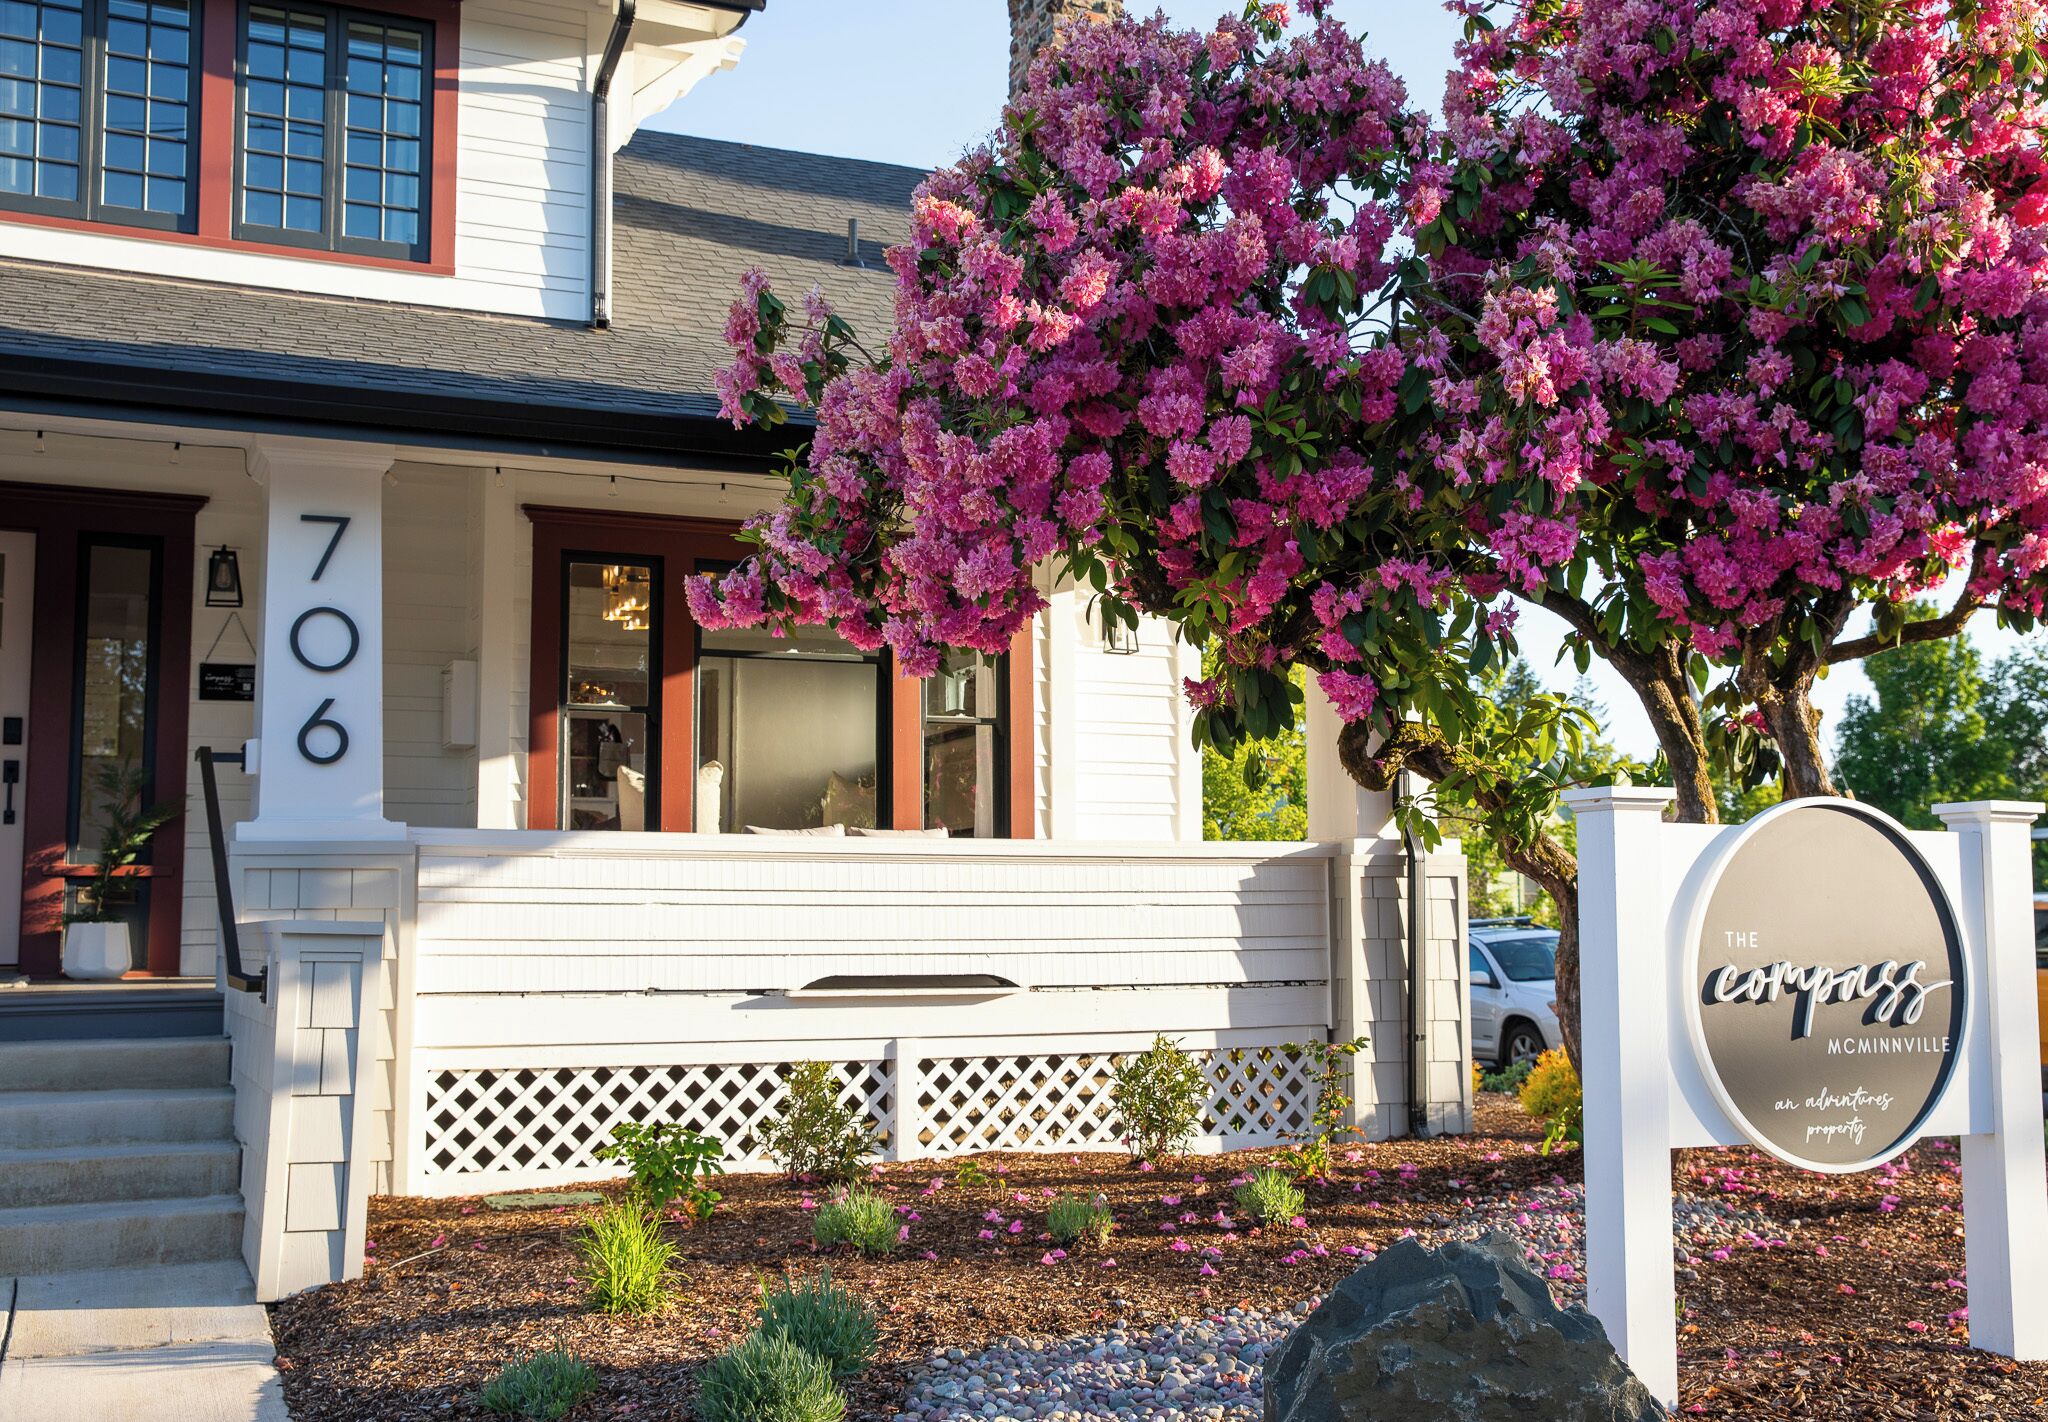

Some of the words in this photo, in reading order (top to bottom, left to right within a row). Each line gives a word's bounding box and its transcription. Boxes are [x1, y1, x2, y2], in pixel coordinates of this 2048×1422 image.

[289, 514, 360, 765] 706
[1725, 931, 1758, 948] THE
[1713, 959, 1954, 1038] compass
[1827, 1036, 1951, 1055] MCMINNVILLE
[1774, 1098, 1800, 1111] an
[1805, 1115, 1867, 1145] property
